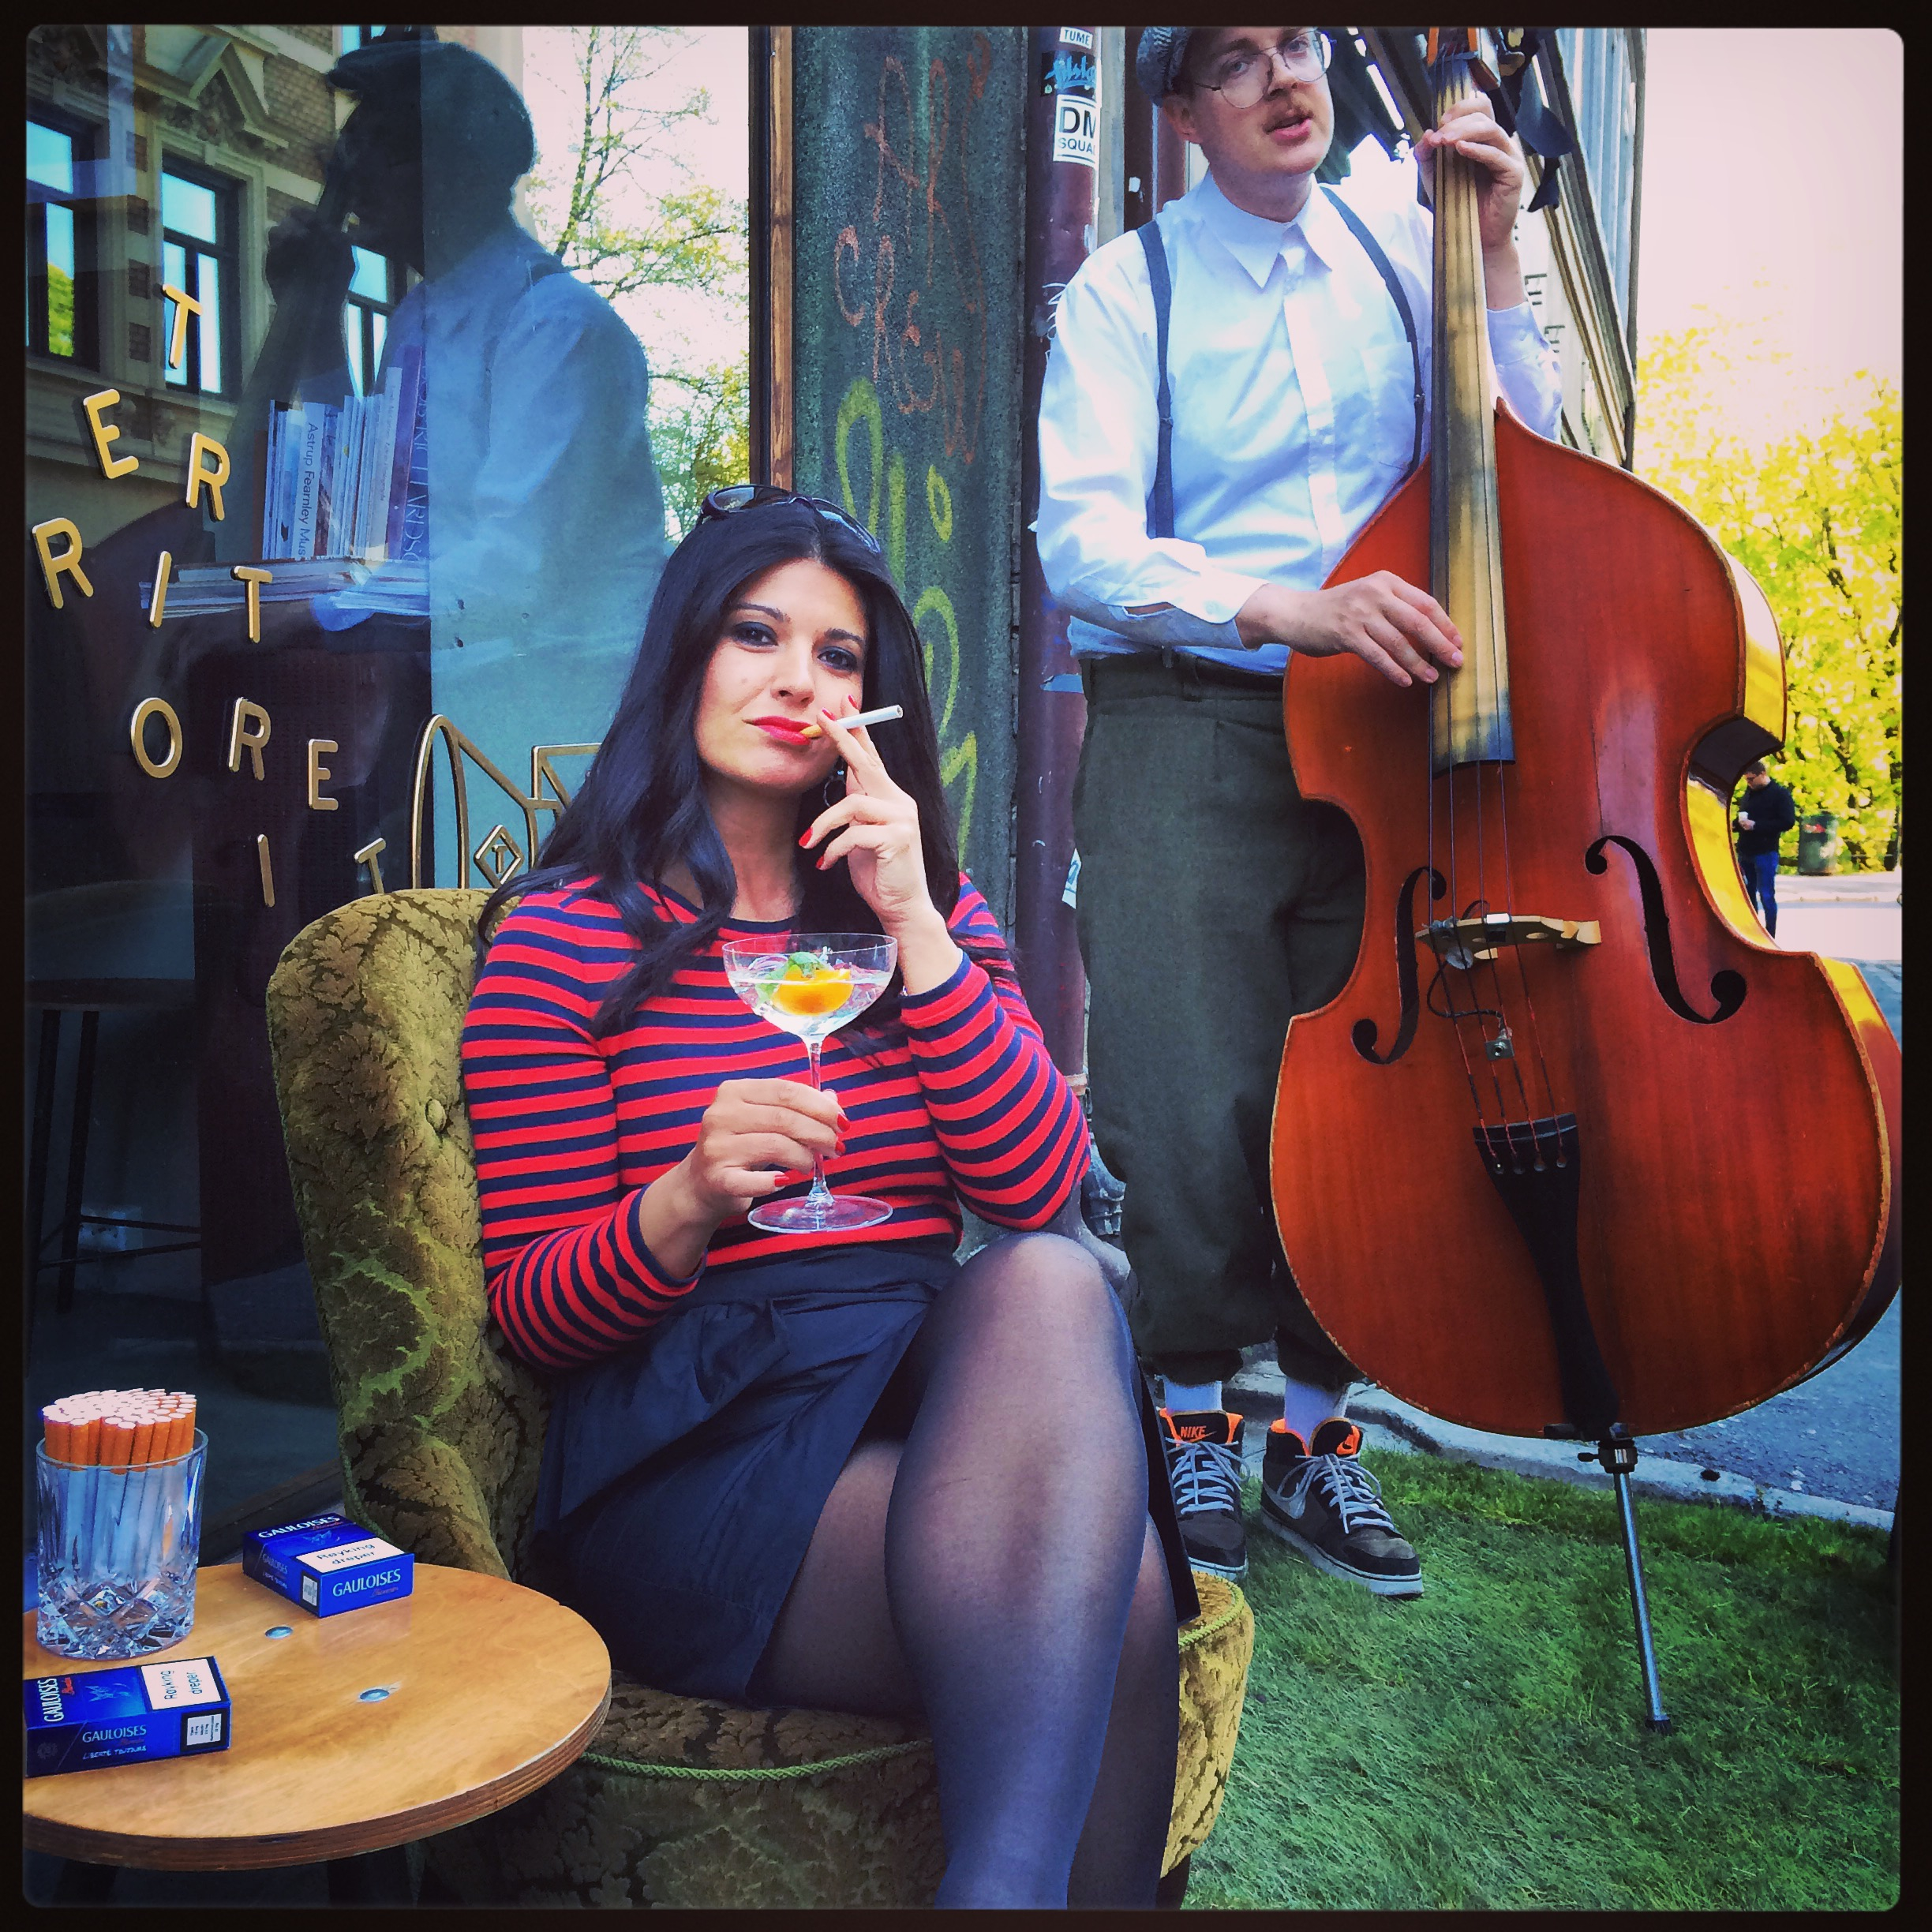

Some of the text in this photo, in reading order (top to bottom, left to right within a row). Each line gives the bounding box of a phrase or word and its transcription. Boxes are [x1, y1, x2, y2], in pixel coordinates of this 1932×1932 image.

[1064, 28, 1091, 47] TUME
[1057, 137, 1095, 156] SQUA
[307, 423, 319, 466] Astrup
[297, 470, 315, 526] Fearnley
[1180, 1425, 1207, 1439] NIKE
[257, 1515, 341, 1539] GAULOISES
[332, 1568, 402, 1598] GAULOISES
[37, 1677, 65, 1723] GAULOISES
[81, 1724, 148, 1744] GAULOISES
